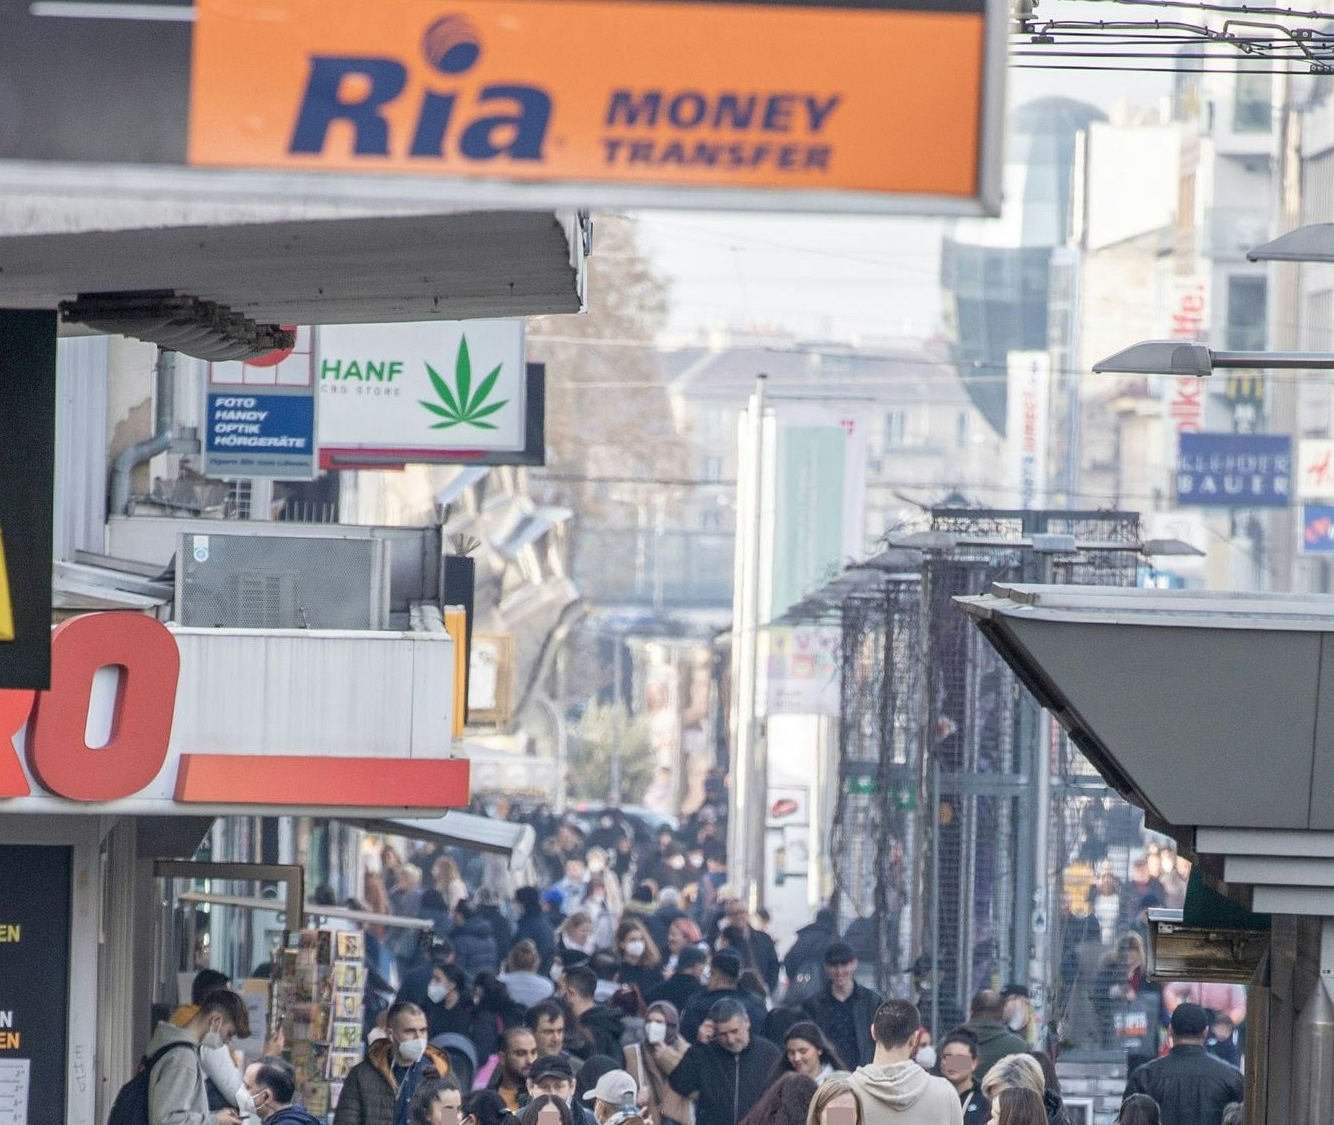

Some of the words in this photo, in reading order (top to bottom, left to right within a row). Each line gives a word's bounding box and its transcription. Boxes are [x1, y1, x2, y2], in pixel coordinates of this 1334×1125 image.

[287, 13, 553, 163] Ria
[604, 89, 842, 135] MONEY
[601, 137, 835, 173] TRANSFER
[320, 358, 405, 383] HANF
[214, 397, 256, 409] FOTO
[214, 410, 268, 422] HANDY
[214, 422, 260, 435] OPTIK
[214, 434, 307, 449] HÖRGERÄTE
[1178, 452, 1291, 474] KLEIDER
[1177, 475, 1291, 496] BAUER
